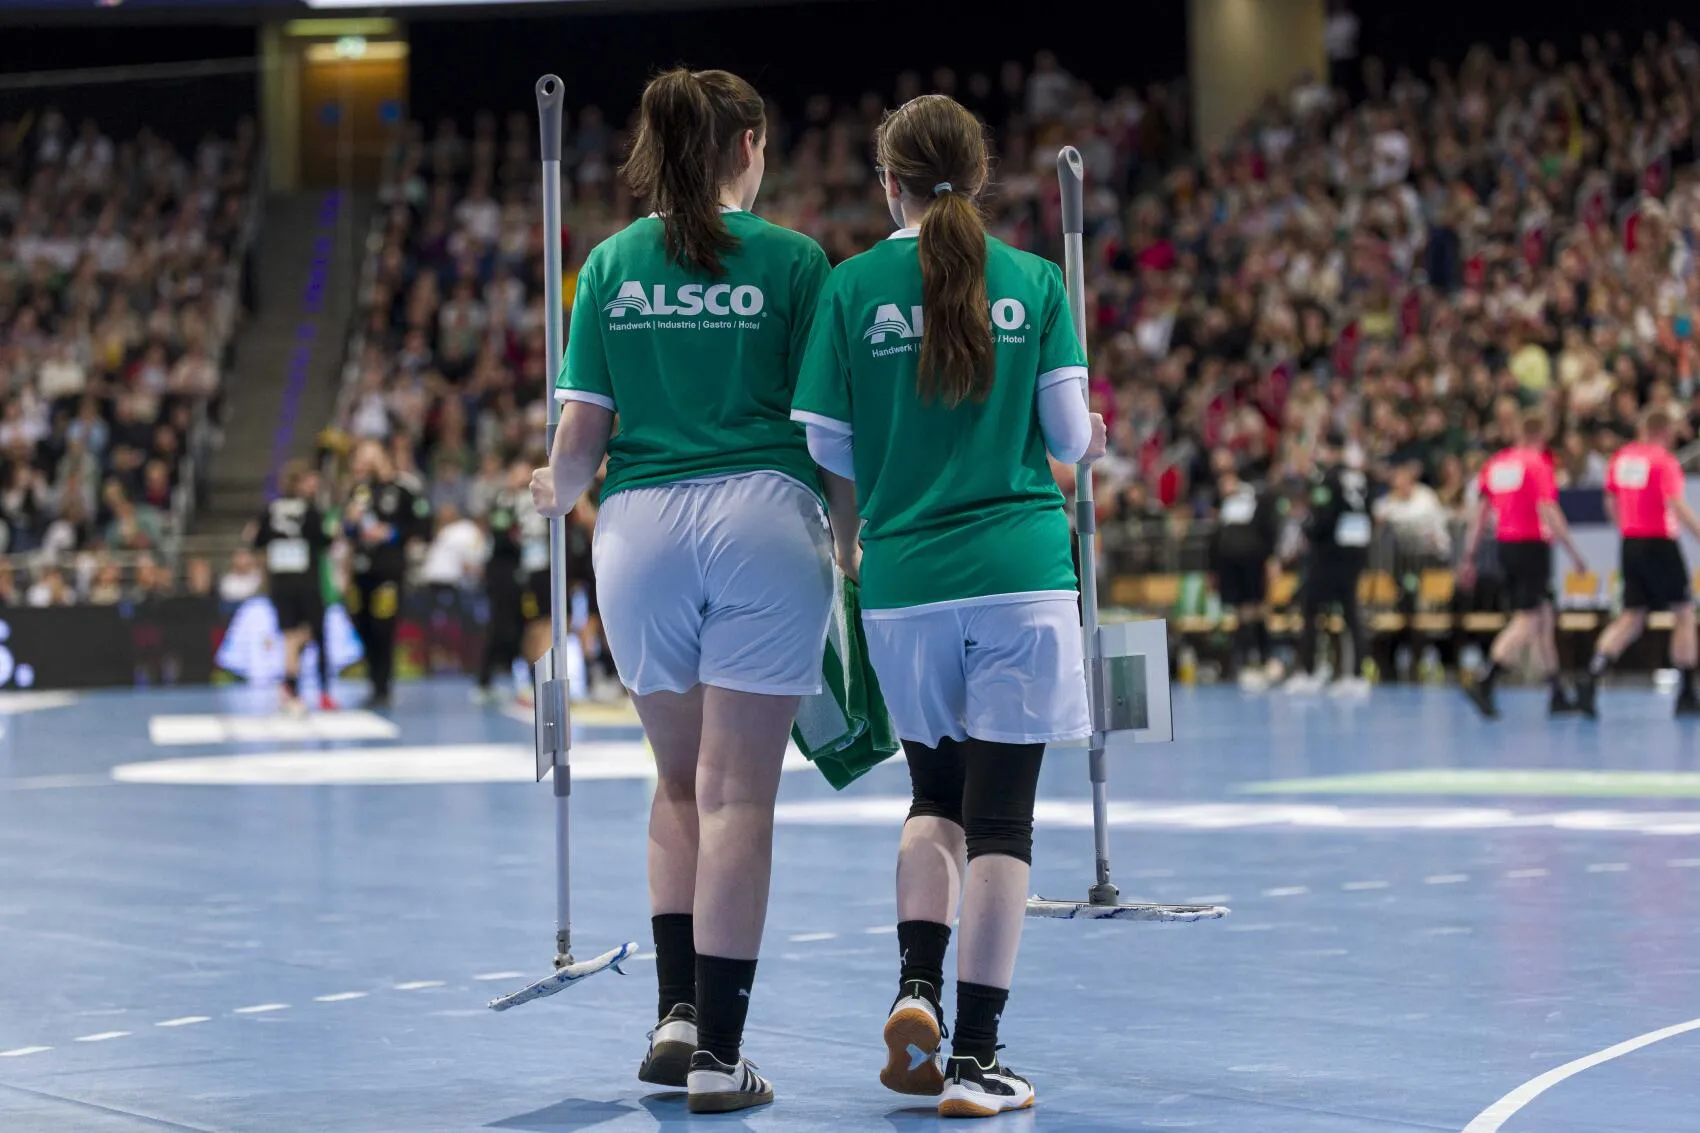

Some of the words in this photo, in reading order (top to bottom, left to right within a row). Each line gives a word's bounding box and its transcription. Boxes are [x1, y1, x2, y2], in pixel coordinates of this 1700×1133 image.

[609, 320, 652, 331] Handwerk
[657, 320, 696, 329] Industrie
[702, 320, 732, 329] Gastro
[738, 320, 760, 330] Hotel
[871, 343, 913, 358] Handwerk
[1002, 334, 1025, 343] Hotel
